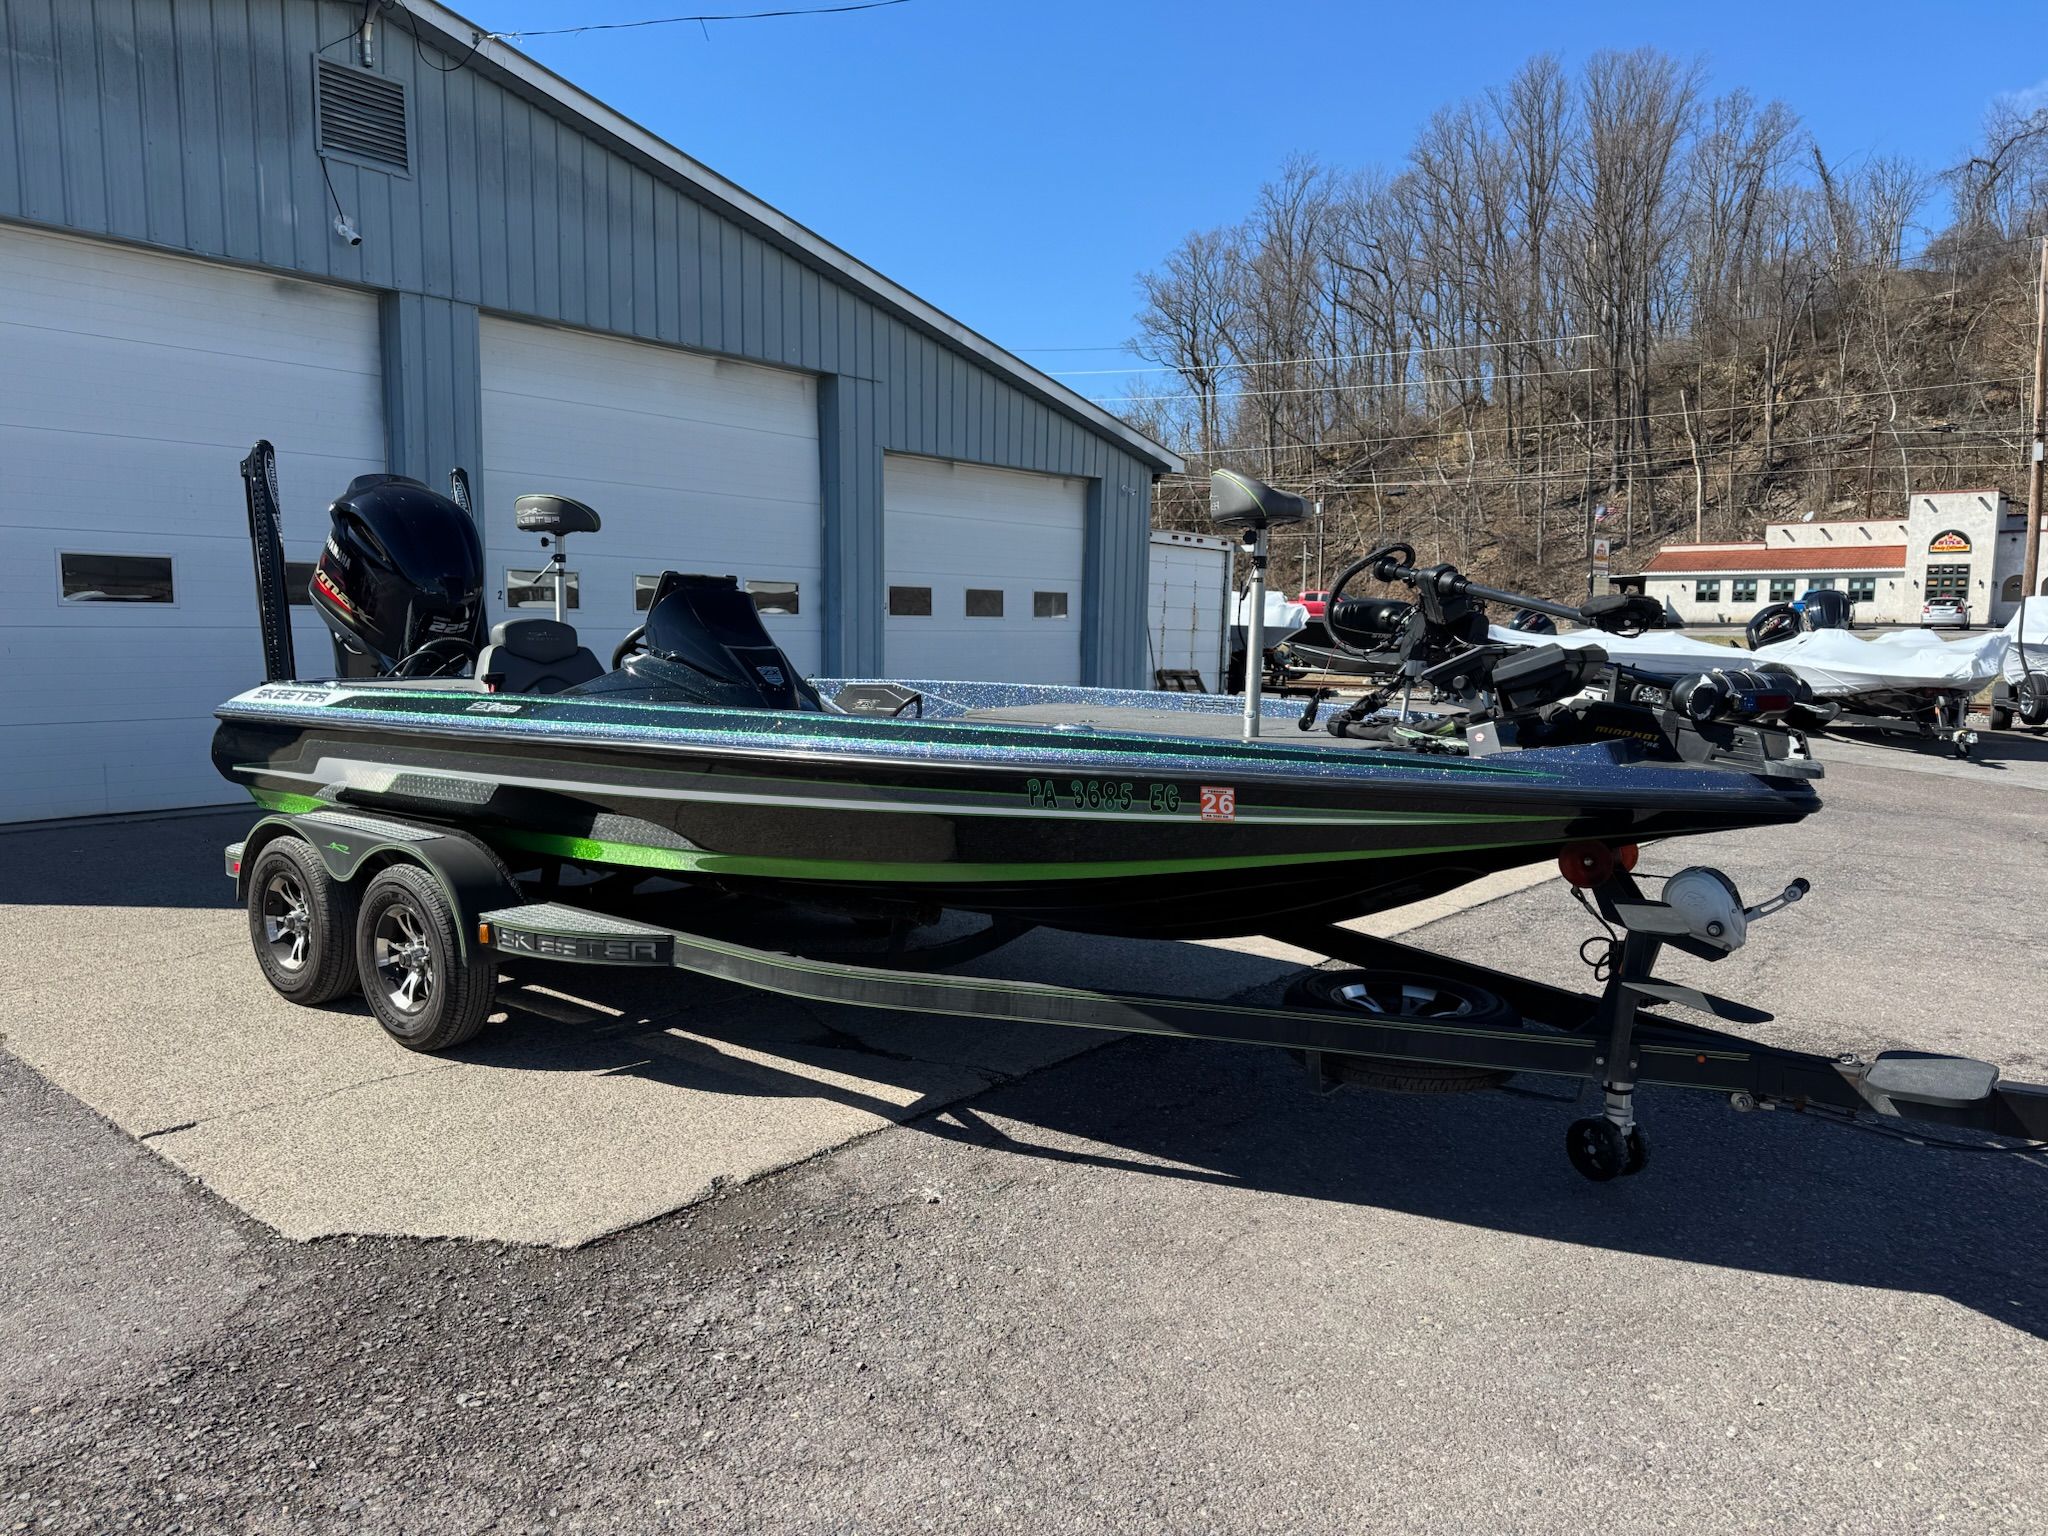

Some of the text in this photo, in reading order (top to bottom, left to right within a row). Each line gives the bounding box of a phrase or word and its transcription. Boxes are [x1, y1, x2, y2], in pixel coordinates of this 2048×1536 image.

[326, 531, 351, 570] YAMAHA
[497, 590, 503, 600] 2
[429, 621, 470, 634] 225
[253, 688, 332, 702] SKEETER
[1027, 778, 1181, 813] PA 3685 EG
[1201, 793, 1234, 814] 26
[500, 929, 656, 961] SKEETER
